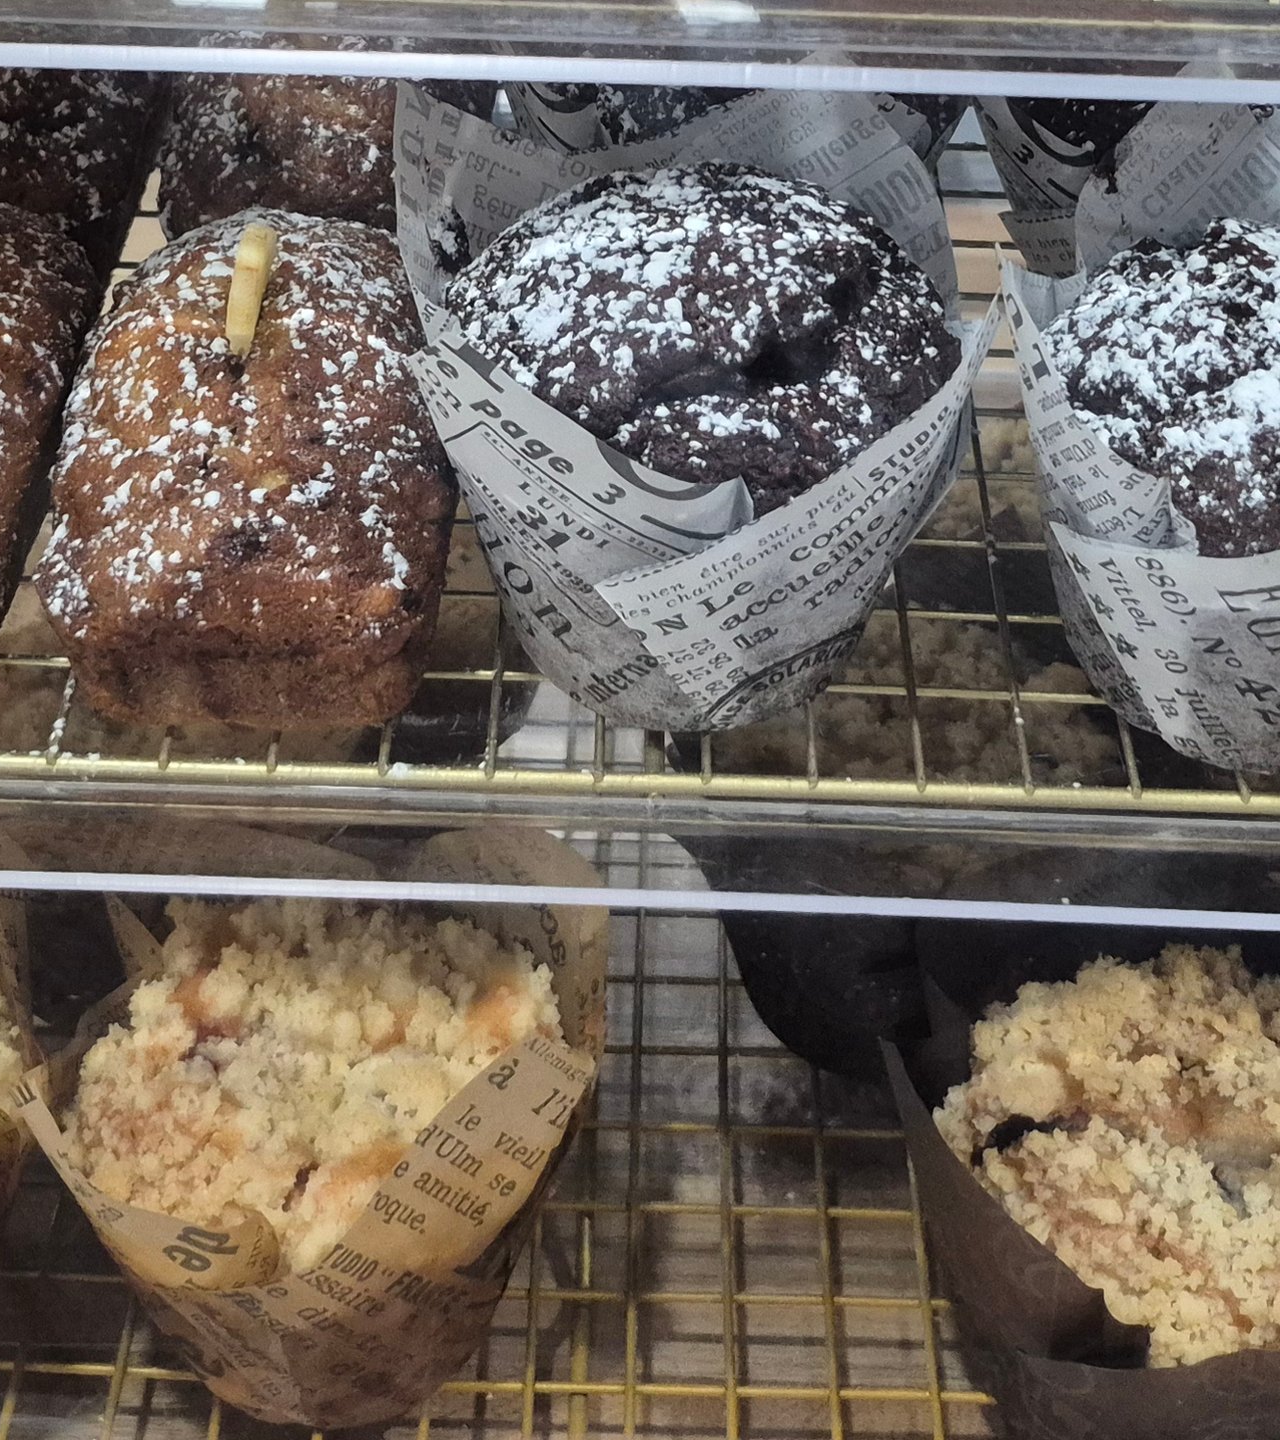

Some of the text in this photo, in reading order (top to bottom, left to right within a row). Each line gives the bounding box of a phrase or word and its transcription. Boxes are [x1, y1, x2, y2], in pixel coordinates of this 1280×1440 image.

[470, 399, 574, 475] page
[593, 483, 626, 505] 3
[516, 505, 570, 554] 31
[518, 482, 610, 548] LUNDI
[553, 560, 594, 595] 1939
[638, 581, 686, 603] bien
[757, 523, 790, 547] sur
[720, 515, 885, 631] accueille
[697, 580, 756, 618] Le
[1098, 556, 1157, 633] Vittel,
[1154, 647, 1188, 674] 30
[487, 1057, 520, 1090] à
[414, 1124, 518, 1197] d'Ulm se
[455, 1103, 546, 1170] le vieil
[413, 1170, 492, 1228] amitié,
